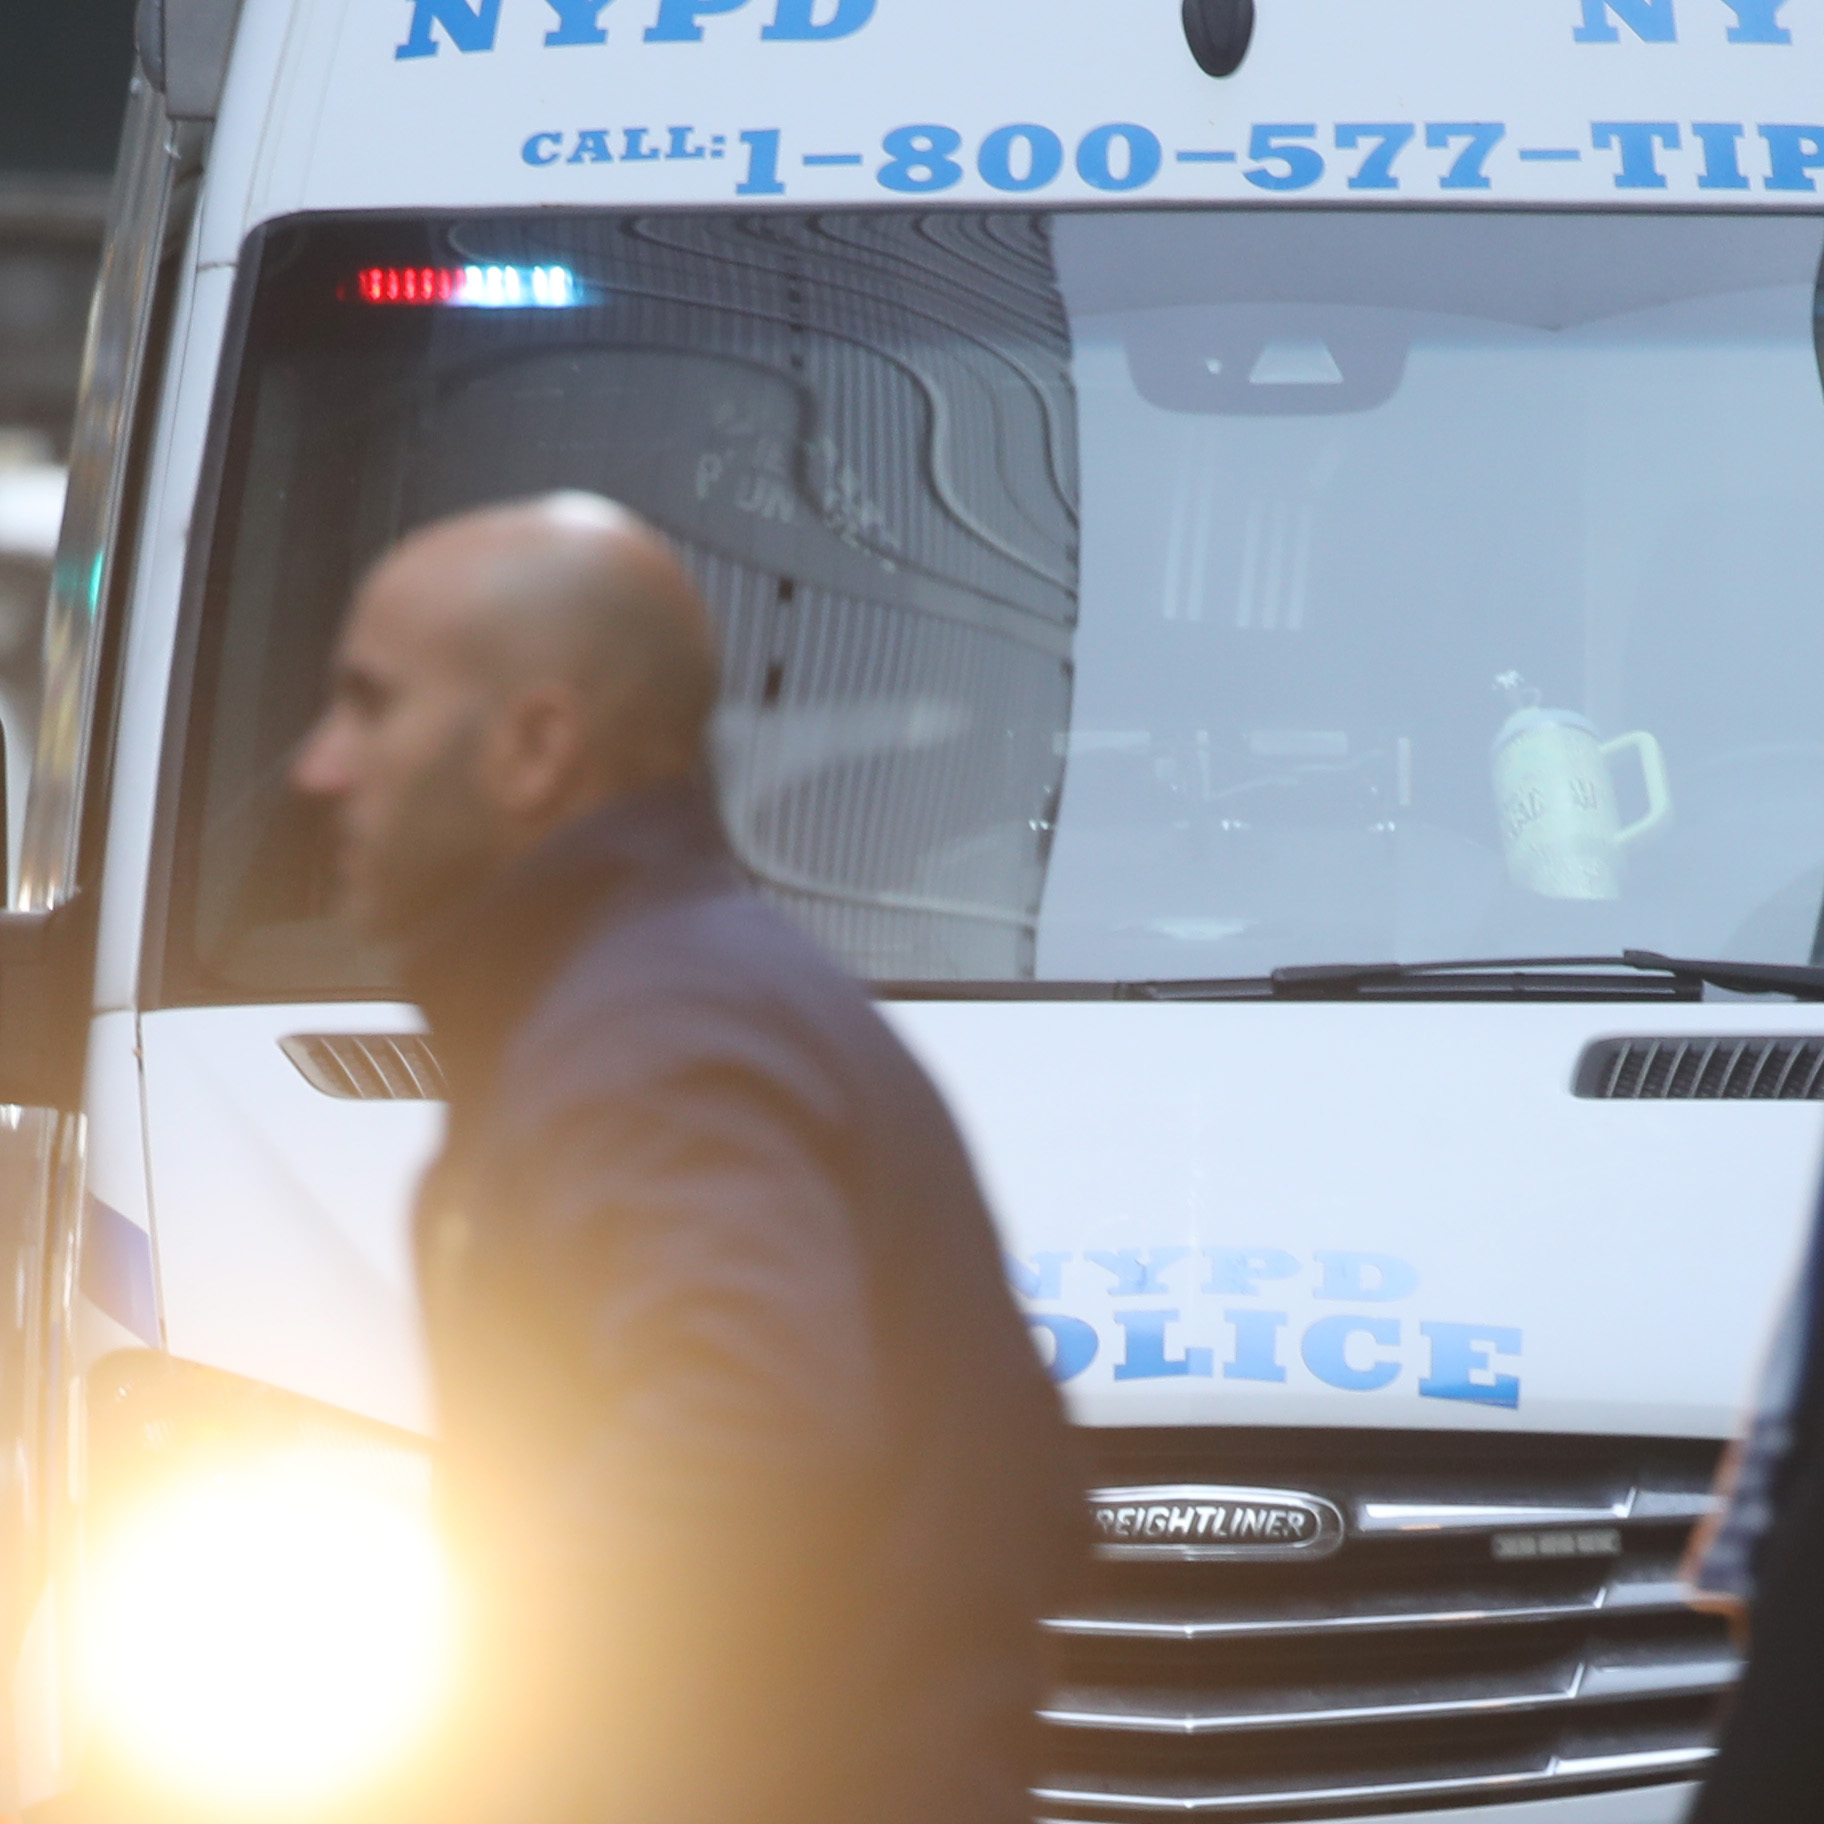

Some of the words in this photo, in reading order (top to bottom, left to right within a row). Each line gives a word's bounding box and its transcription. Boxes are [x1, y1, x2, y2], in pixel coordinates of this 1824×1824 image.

[394, 0, 878, 61] NYPD
[1021, 1308, 1523, 1411] OLICE
[1094, 1504, 1307, 1538] REIGHTLINER
